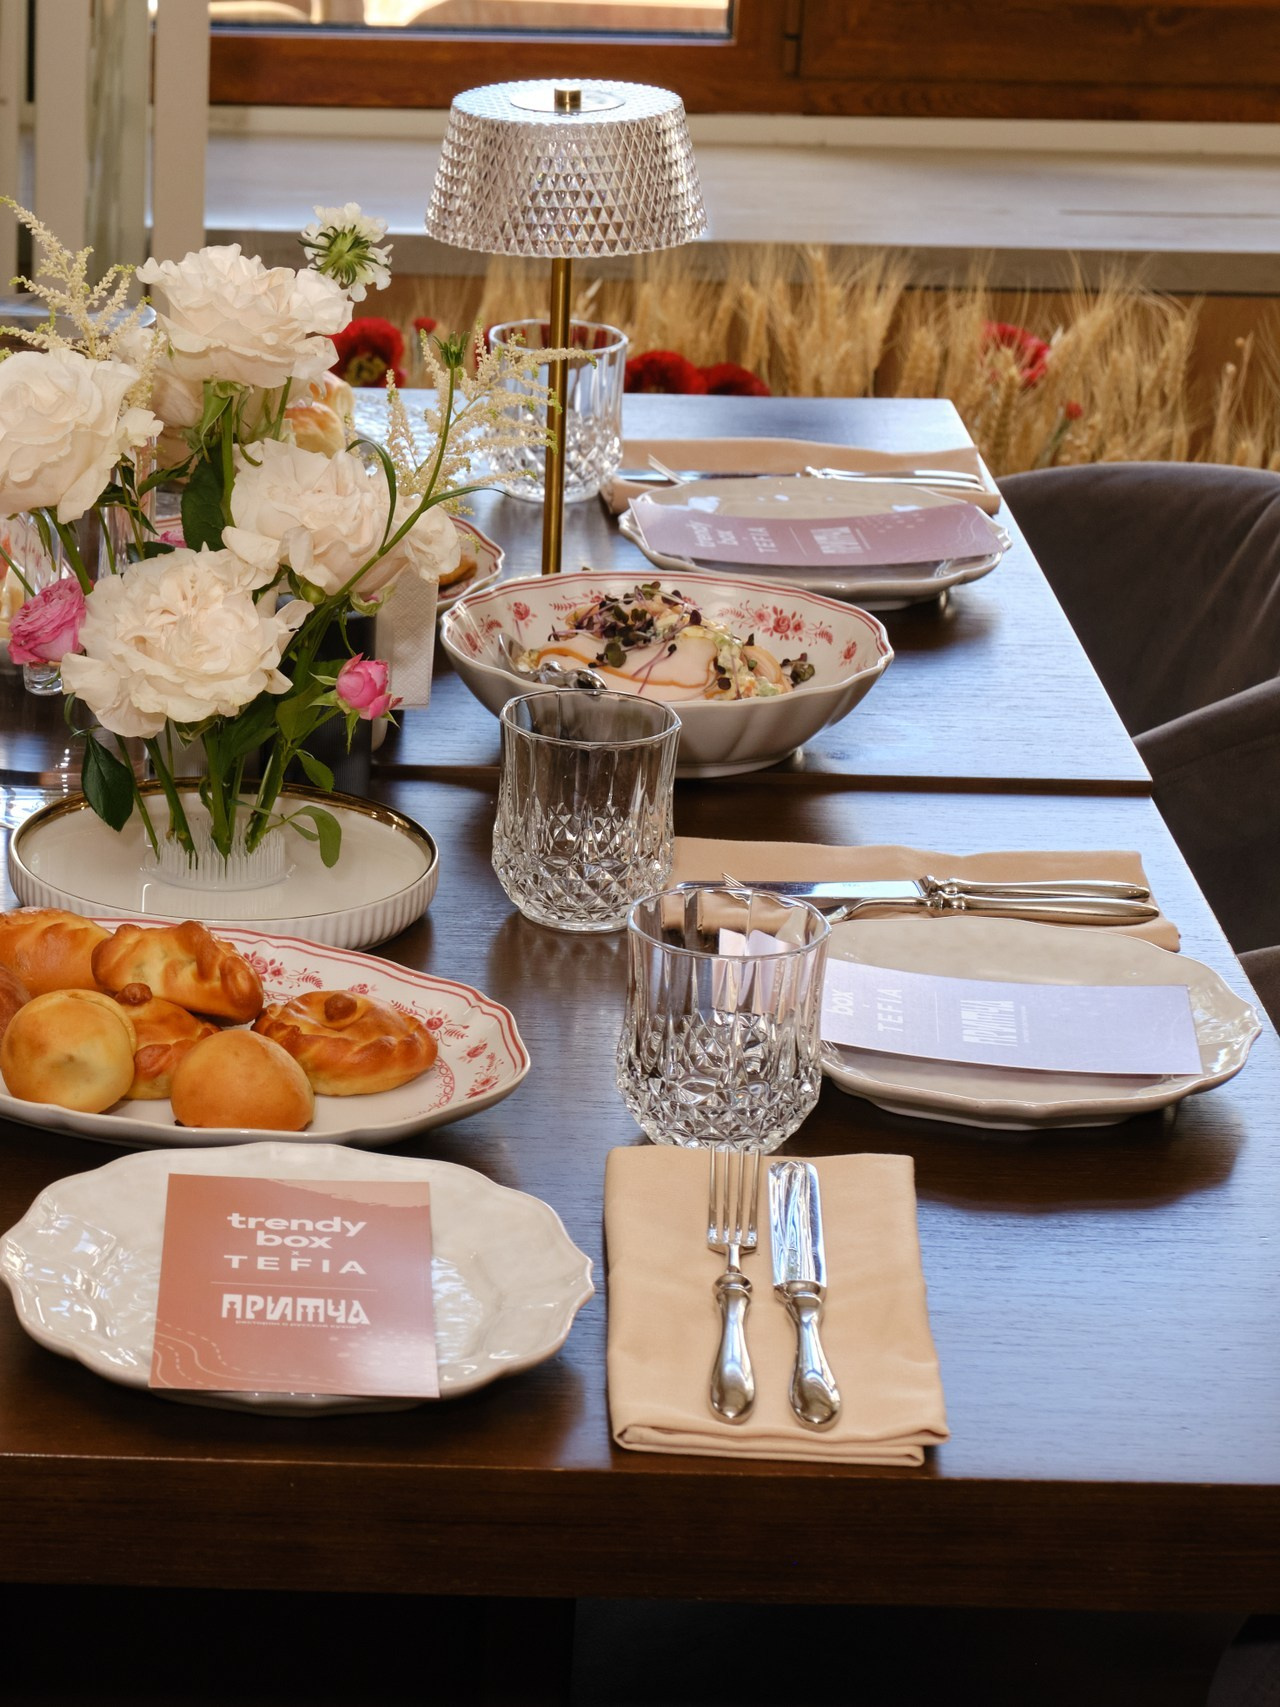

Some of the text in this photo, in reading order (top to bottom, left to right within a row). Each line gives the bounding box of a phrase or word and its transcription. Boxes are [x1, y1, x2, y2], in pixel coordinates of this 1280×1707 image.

[824, 989, 854, 1017] box
[877, 988, 903, 1033] TEFIA
[226, 1212, 367, 1237] trendy
[256, 1230, 332, 1249] box
[224, 1254, 368, 1275] TEFIA
[221, 1293, 371, 1325] ПРИТЧА
